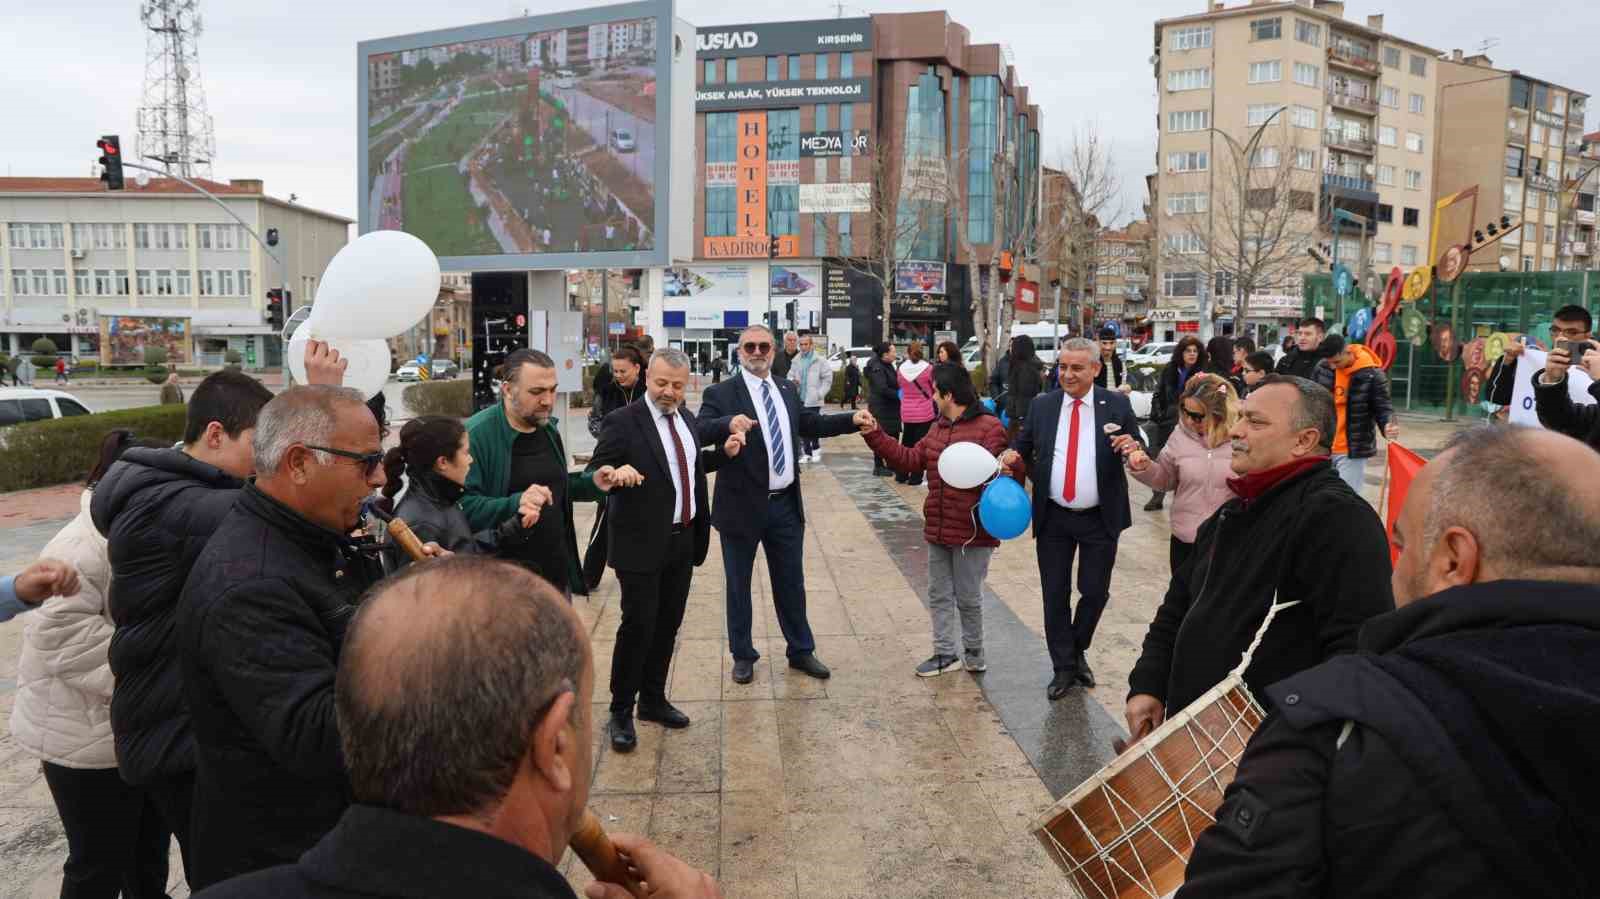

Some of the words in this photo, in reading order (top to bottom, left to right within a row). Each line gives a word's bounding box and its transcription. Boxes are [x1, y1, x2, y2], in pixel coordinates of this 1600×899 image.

[696, 89, 725, 101] ÜKSEK
[766, 86, 804, 98] YÜKSEK
[744, 122, 760, 229] HOTEL
